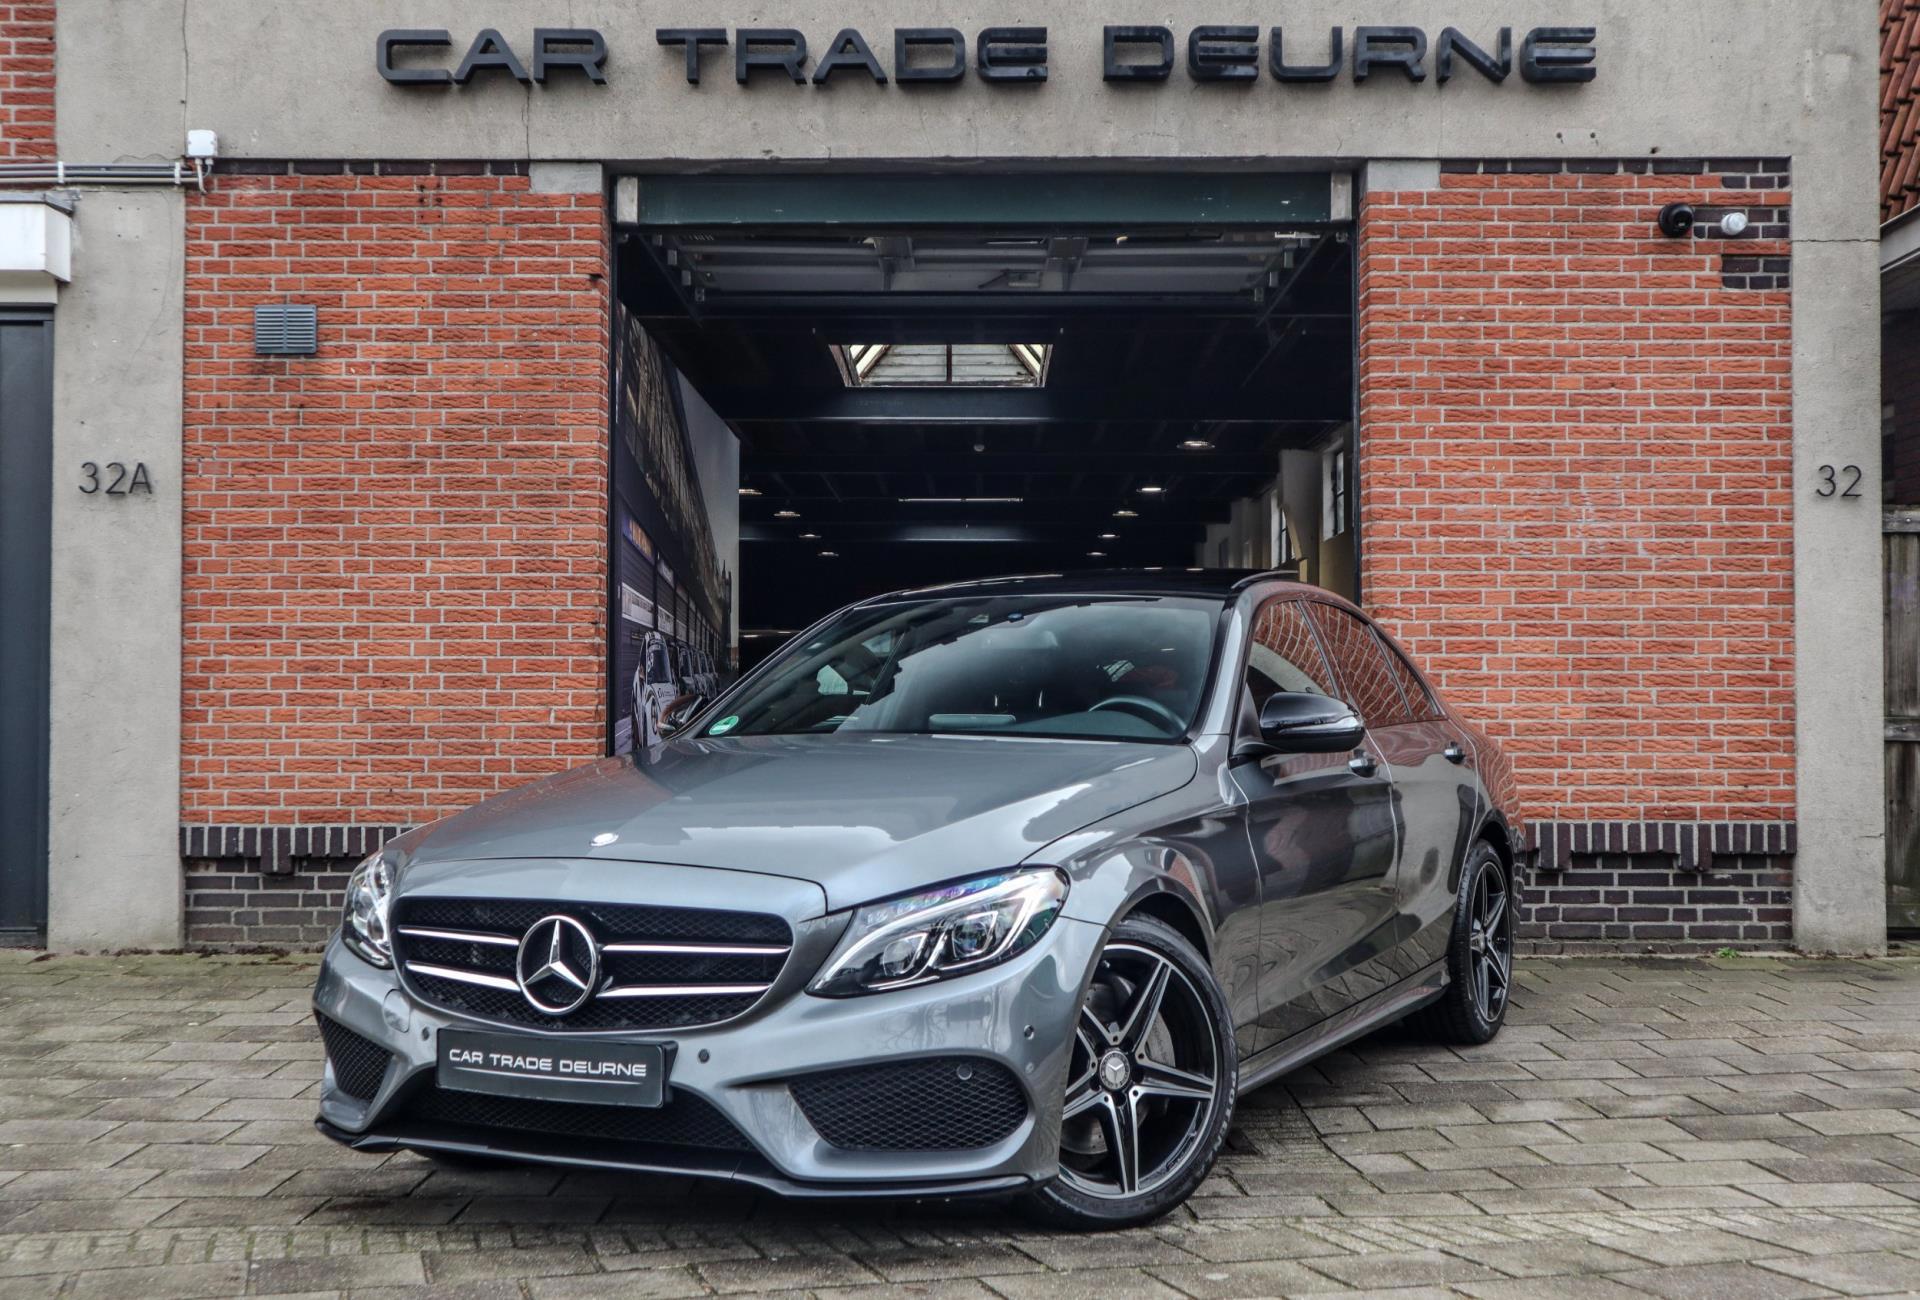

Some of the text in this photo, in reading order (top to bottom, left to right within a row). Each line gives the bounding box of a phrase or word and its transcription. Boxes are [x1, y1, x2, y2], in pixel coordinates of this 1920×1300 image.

[376, 25, 1596, 85] CAR TRADE DEURNE
[78, 462, 152, 494] 32A
[1816, 464, 1862, 497] 32
[449, 1049, 647, 1077] CAR TRADE DEURNE
